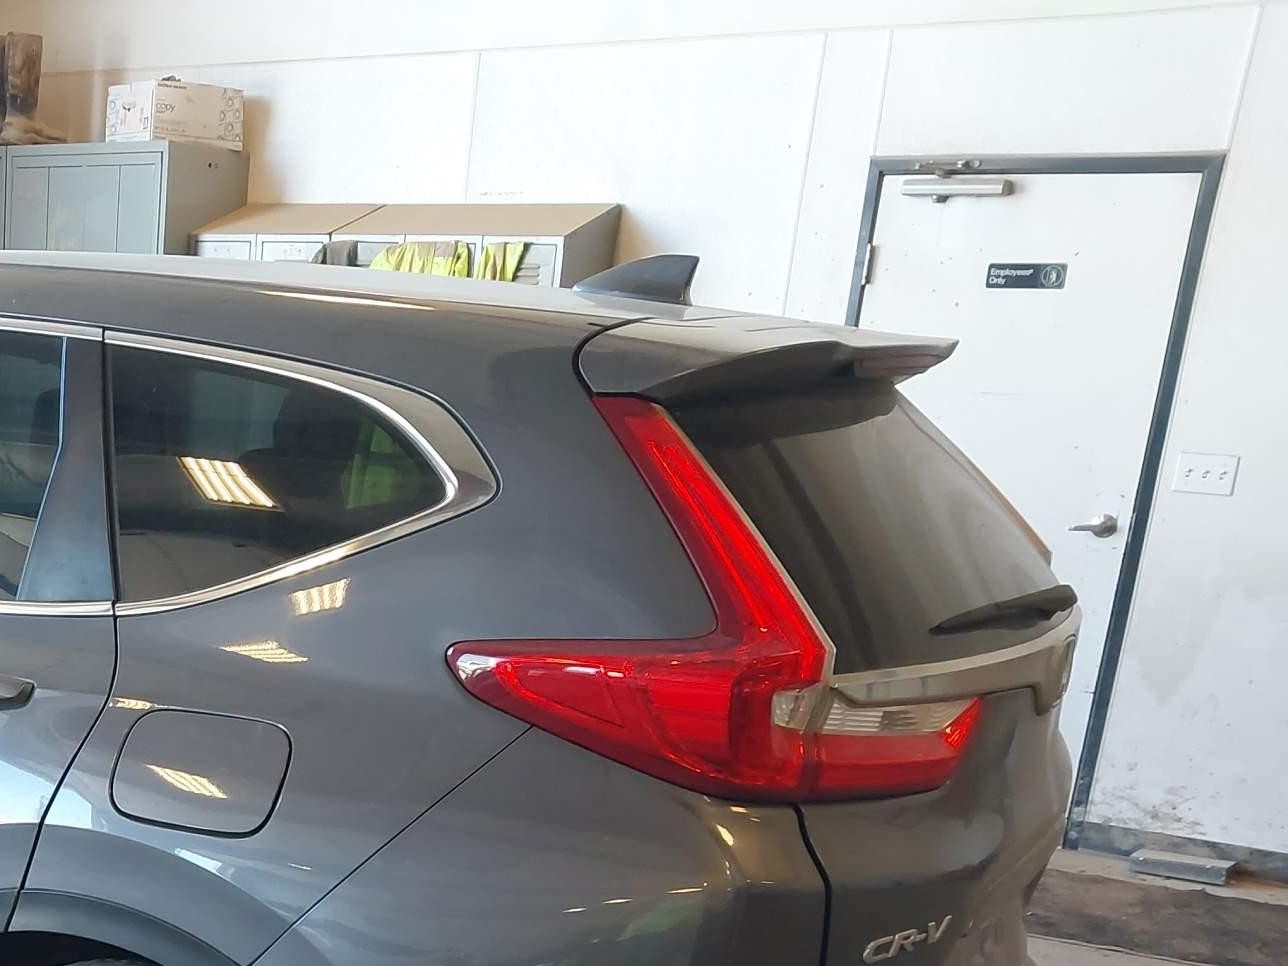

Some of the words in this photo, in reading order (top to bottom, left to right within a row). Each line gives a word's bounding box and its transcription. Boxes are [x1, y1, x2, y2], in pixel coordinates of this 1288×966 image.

[155, 102, 176, 113] copy
[988, 276, 1006, 285] Only
[862, 915, 953, 964] CR-V
